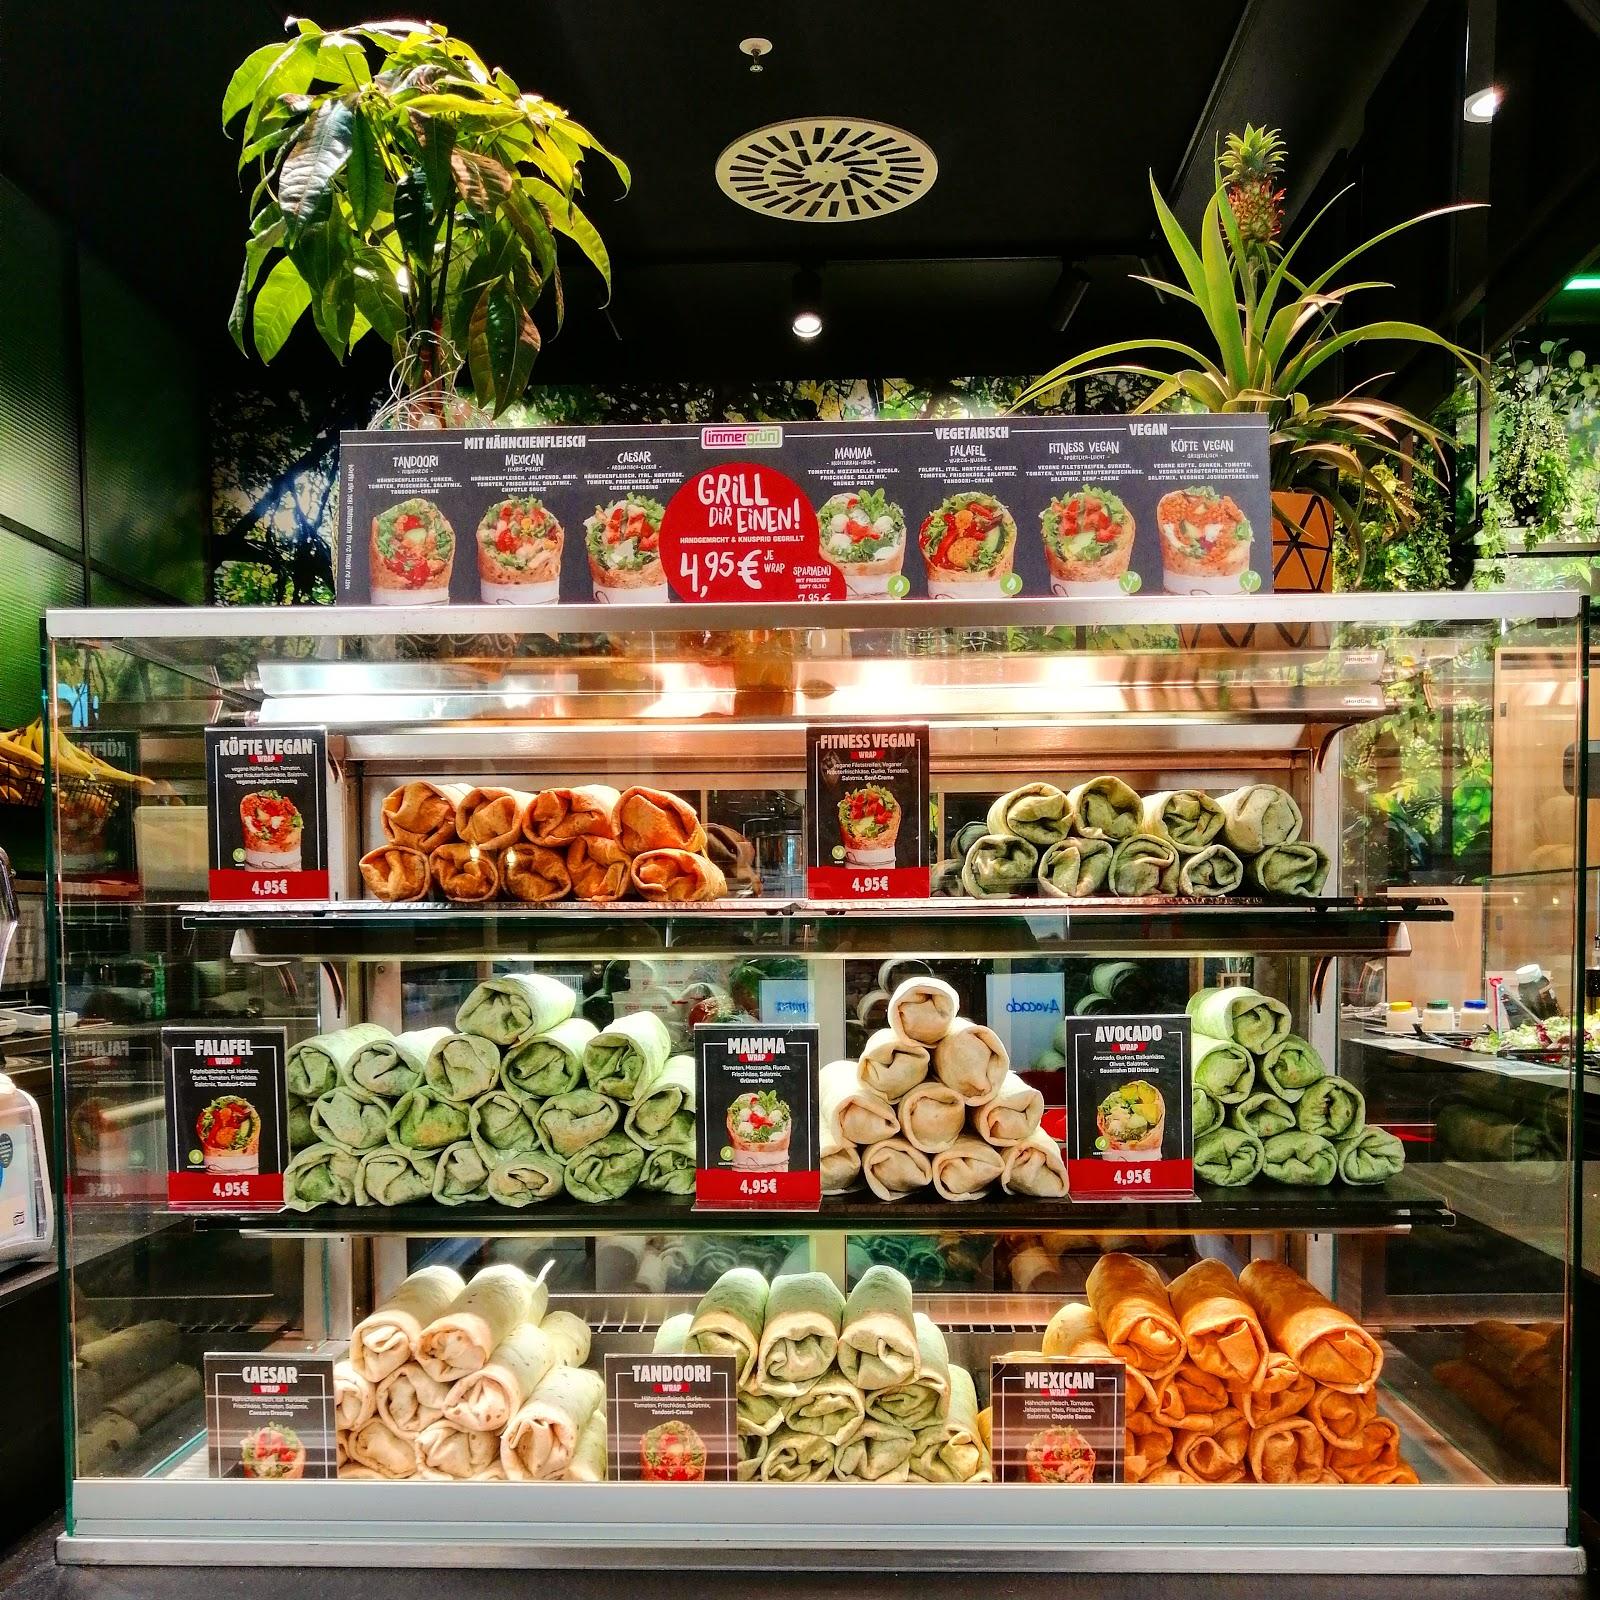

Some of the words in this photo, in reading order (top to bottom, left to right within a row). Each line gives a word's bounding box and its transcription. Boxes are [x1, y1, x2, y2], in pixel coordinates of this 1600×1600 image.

[707, 428, 777, 445] immergrün
[935, 426, 1009, 440] VEGETARISCH
[1129, 424, 1168, 437] VEGAN
[464, 438, 484, 449] MIT
[486, 435, 586, 449] HÄHNCHENFLEISCH
[1049, 442, 1085, 454] FITNESS
[1089, 441, 1120, 454] VEGAN
[1171, 439, 1198, 452] KÖFTE
[1203, 440, 1234, 452] VEGAN
[617, 450, 652, 464] CAESAR
[834, 447, 873, 460] MAMMA
[950, 444, 985, 457] FALAFEL
[392, 455, 439, 468] TANDOORI
[505, 454, 544, 466] MEXICAN
[764, 550, 774, 561] JE
[764, 563, 785, 574] WRAP
[793, 565, 831, 577] SPARMENÜ
[220, 737, 263, 756] KÖFTE
[265, 739, 312, 755] VEGAN
[820, 734, 870, 749] FITNESS
[872, 733, 915, 748] VEGAN
[252, 879, 288, 895] 4,95€
[852, 876, 888, 892] 4,95€
[1095, 1025, 1162, 1042] AVOCADO
[195, 1040, 253, 1055] FALAFEL
[728, 1038, 786, 1054] MAMMA
[1114, 1169, 1151, 1185] 4,95€
[213, 1181, 249, 1197] 4,95€
[740, 1179, 777, 1194] 4,95€
[242, 1366, 298, 1383] CAESAR
[632, 1365, 711, 1382] TANDOORI
[1025, 1372, 1094, 1389] MEXICAN
